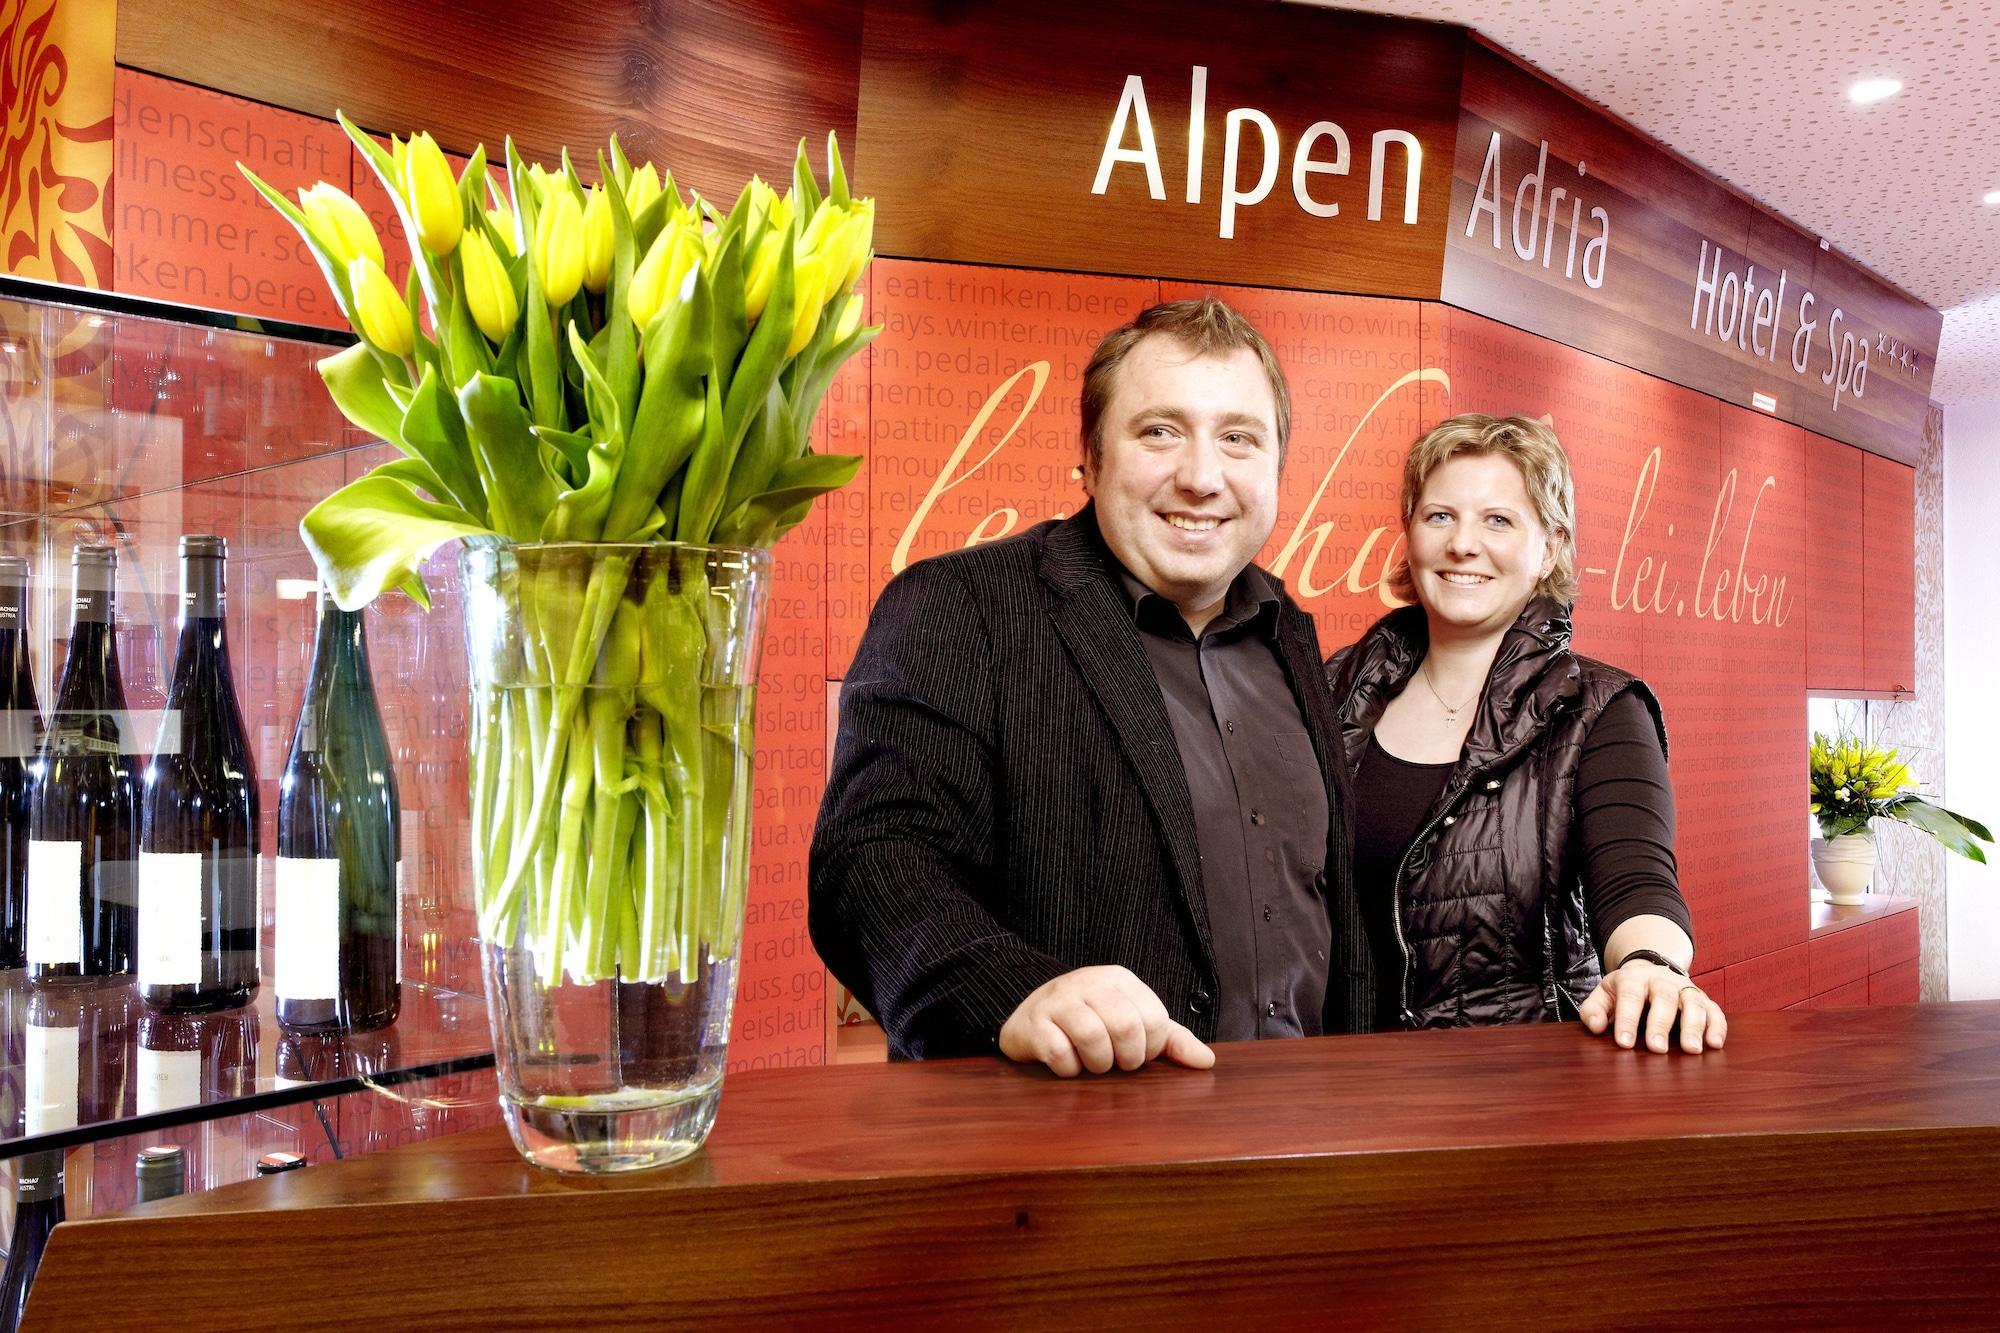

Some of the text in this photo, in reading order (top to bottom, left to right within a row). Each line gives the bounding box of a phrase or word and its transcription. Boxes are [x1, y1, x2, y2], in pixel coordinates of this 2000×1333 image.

[1091, 65, 1422, 239] Alpen
[1465, 131, 1609, 288] Adria
[1691, 240, 1869, 411] Hotel & Spa
